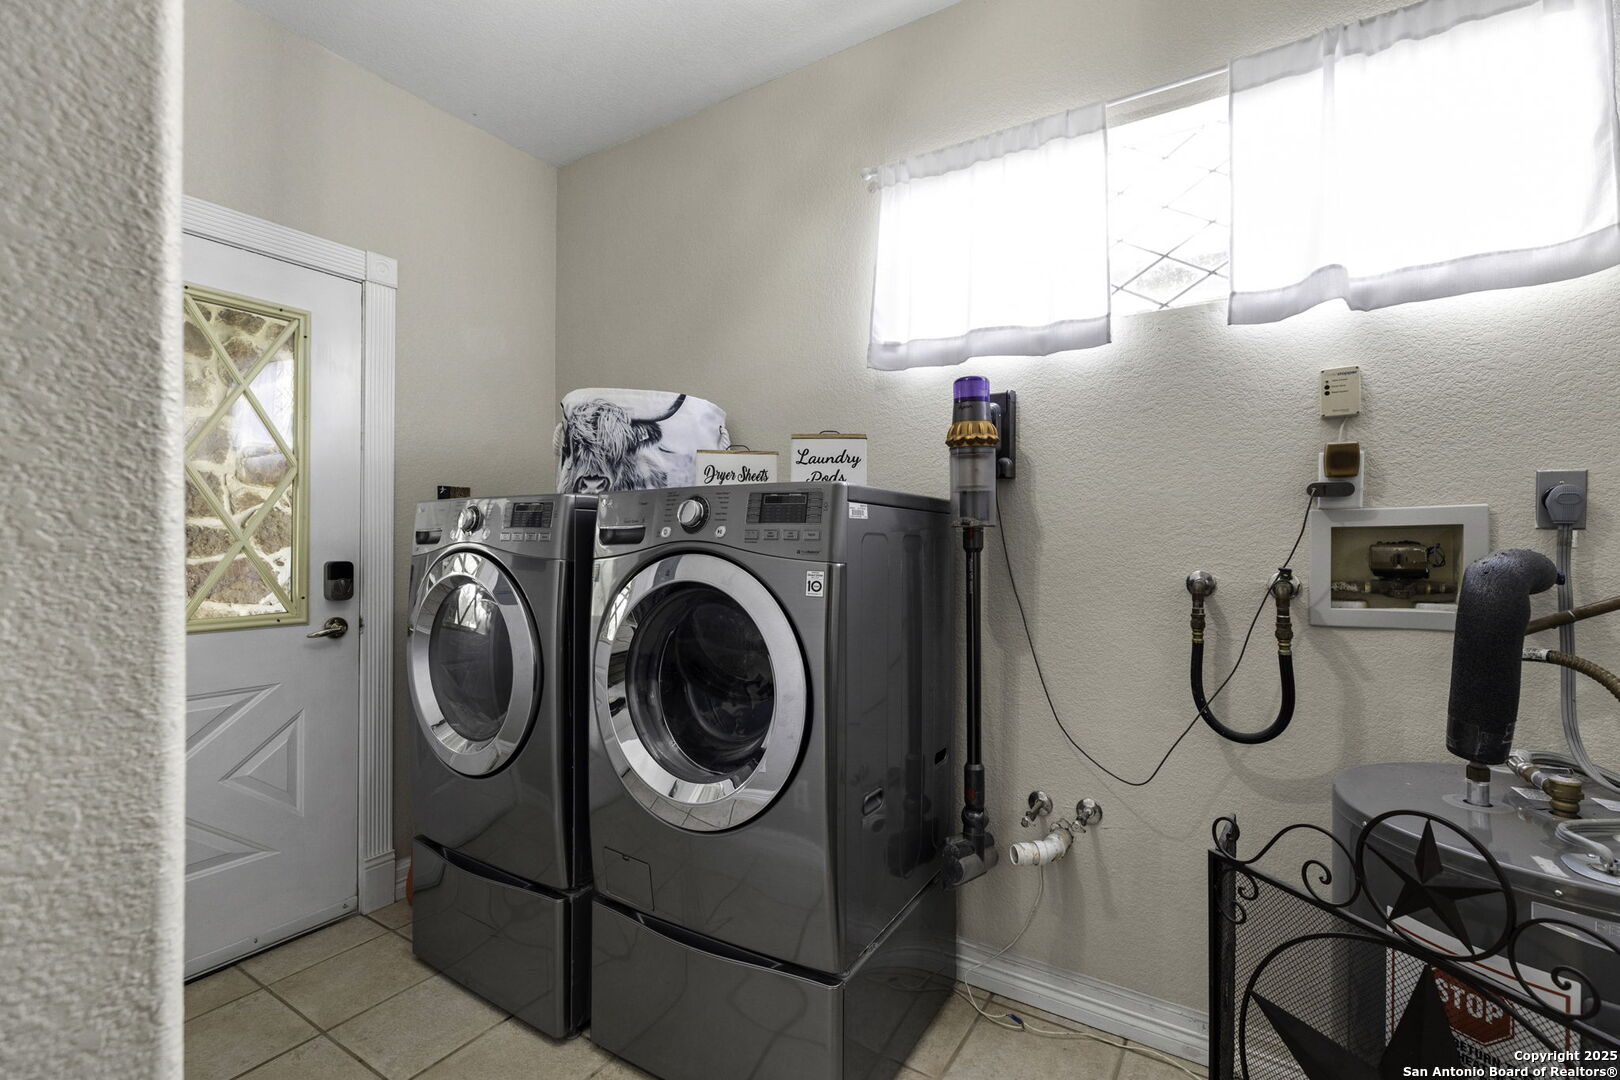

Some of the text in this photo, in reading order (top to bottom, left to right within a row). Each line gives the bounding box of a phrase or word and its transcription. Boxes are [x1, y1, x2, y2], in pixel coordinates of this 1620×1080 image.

[795, 448, 862, 469] Laundry
[703, 464, 769, 485] Dryer Sheets
[805, 468, 847, 483] Pods
[1434, 977, 1505, 1025] STOP
